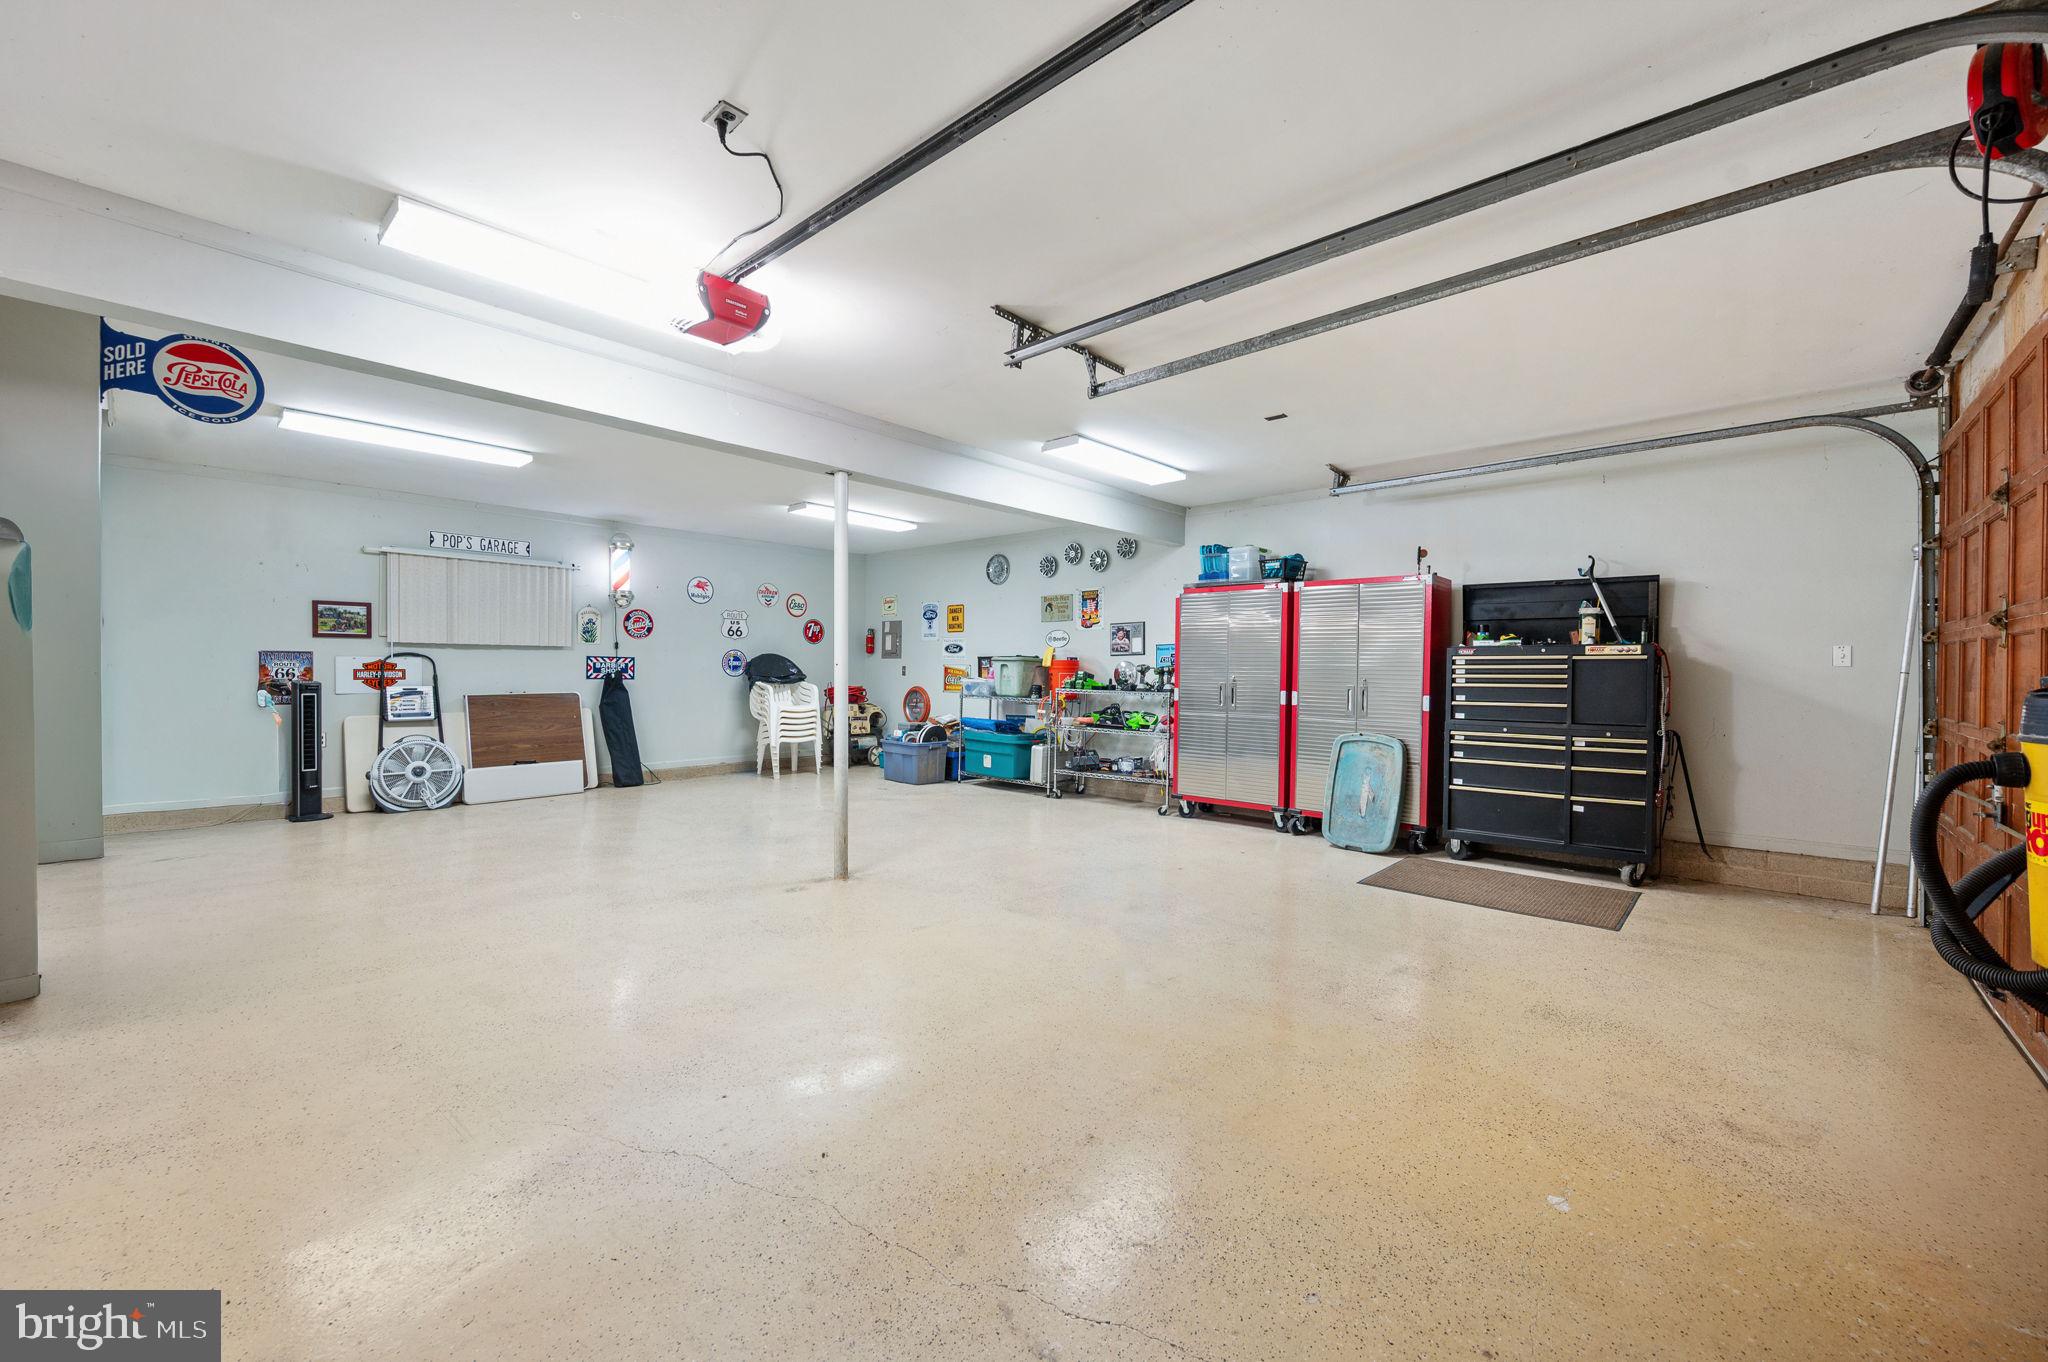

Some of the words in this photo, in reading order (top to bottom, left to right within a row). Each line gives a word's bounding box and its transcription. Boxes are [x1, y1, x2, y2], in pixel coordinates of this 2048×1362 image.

[103, 342, 146, 363] SOLD
[103, 359, 146, 381] HERE
[172, 404, 196, 418] ICE
[442, 533, 473, 550] POP'S
[480, 538, 519, 554] GARAGE
[789, 598, 804, 610] Esso
[727, 626, 743, 637] 66
[274, 668, 296, 681] 66
